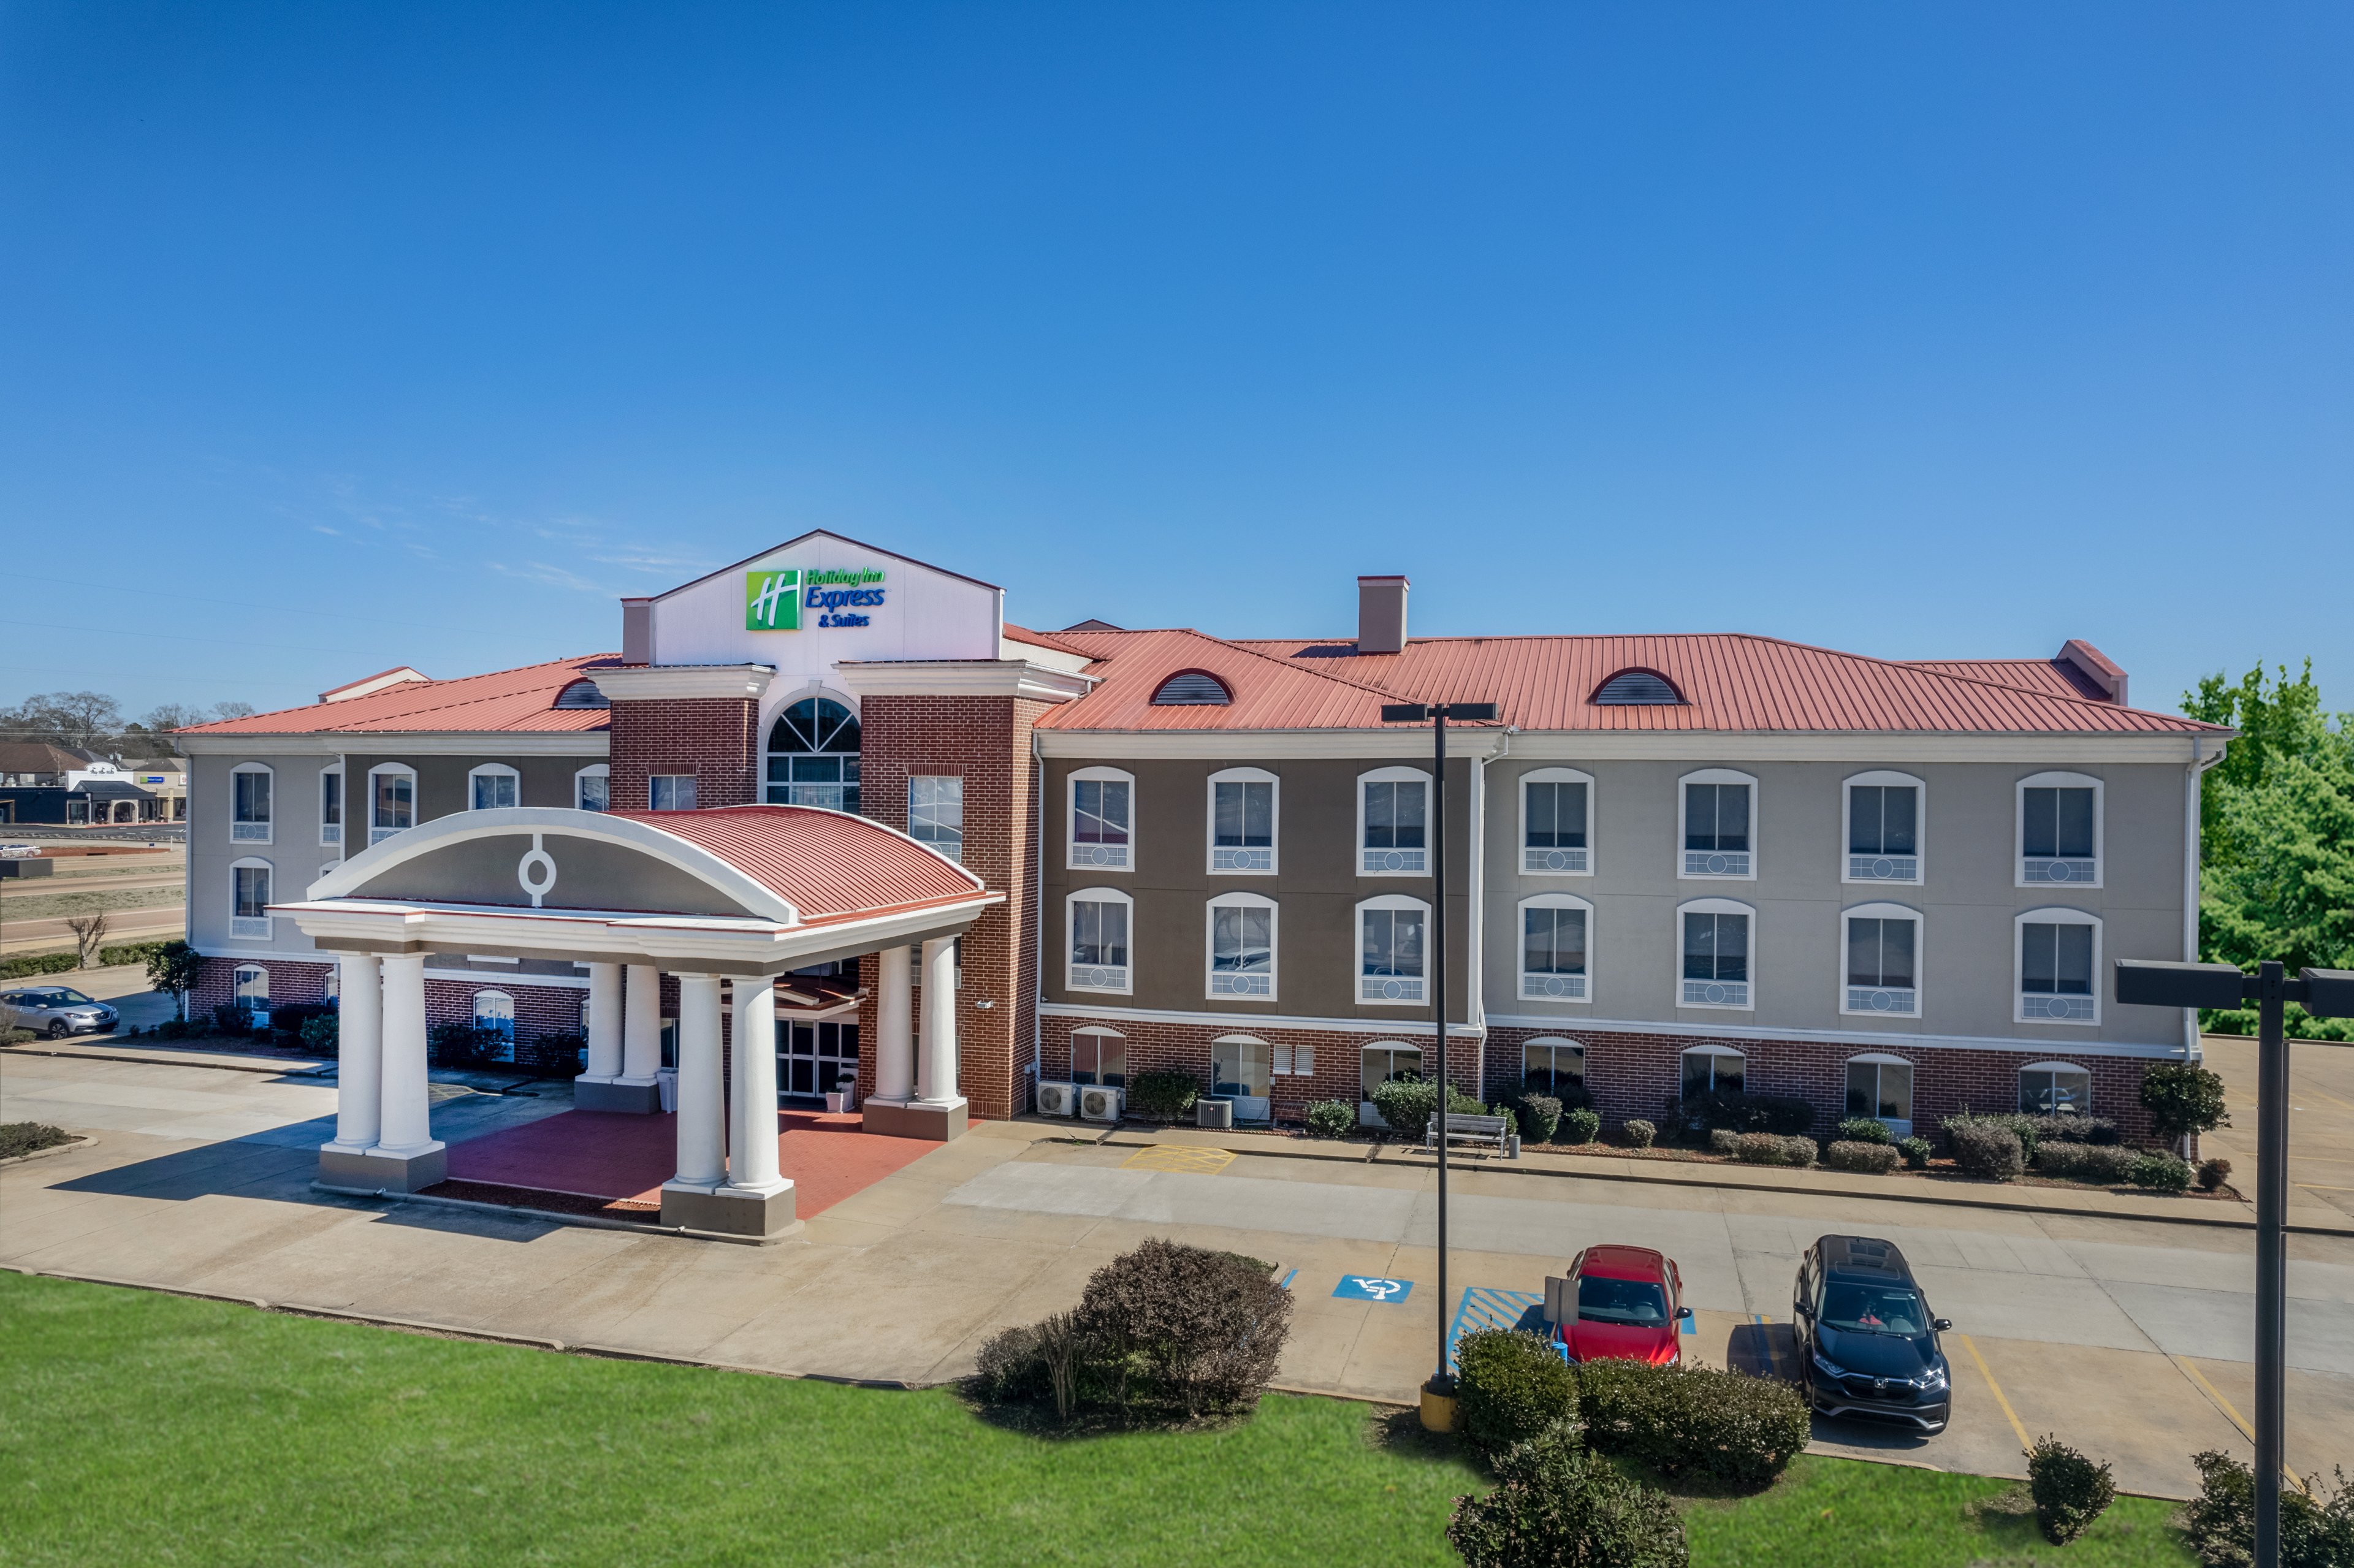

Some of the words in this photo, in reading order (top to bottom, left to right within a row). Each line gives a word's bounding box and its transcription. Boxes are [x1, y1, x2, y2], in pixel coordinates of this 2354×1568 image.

[806, 568, 861, 587] Holiday
[862, 567, 885, 583] Inn
[806, 587, 885, 613] Express
[818, 615, 829, 627] &
[830, 614, 869, 626] Suites
